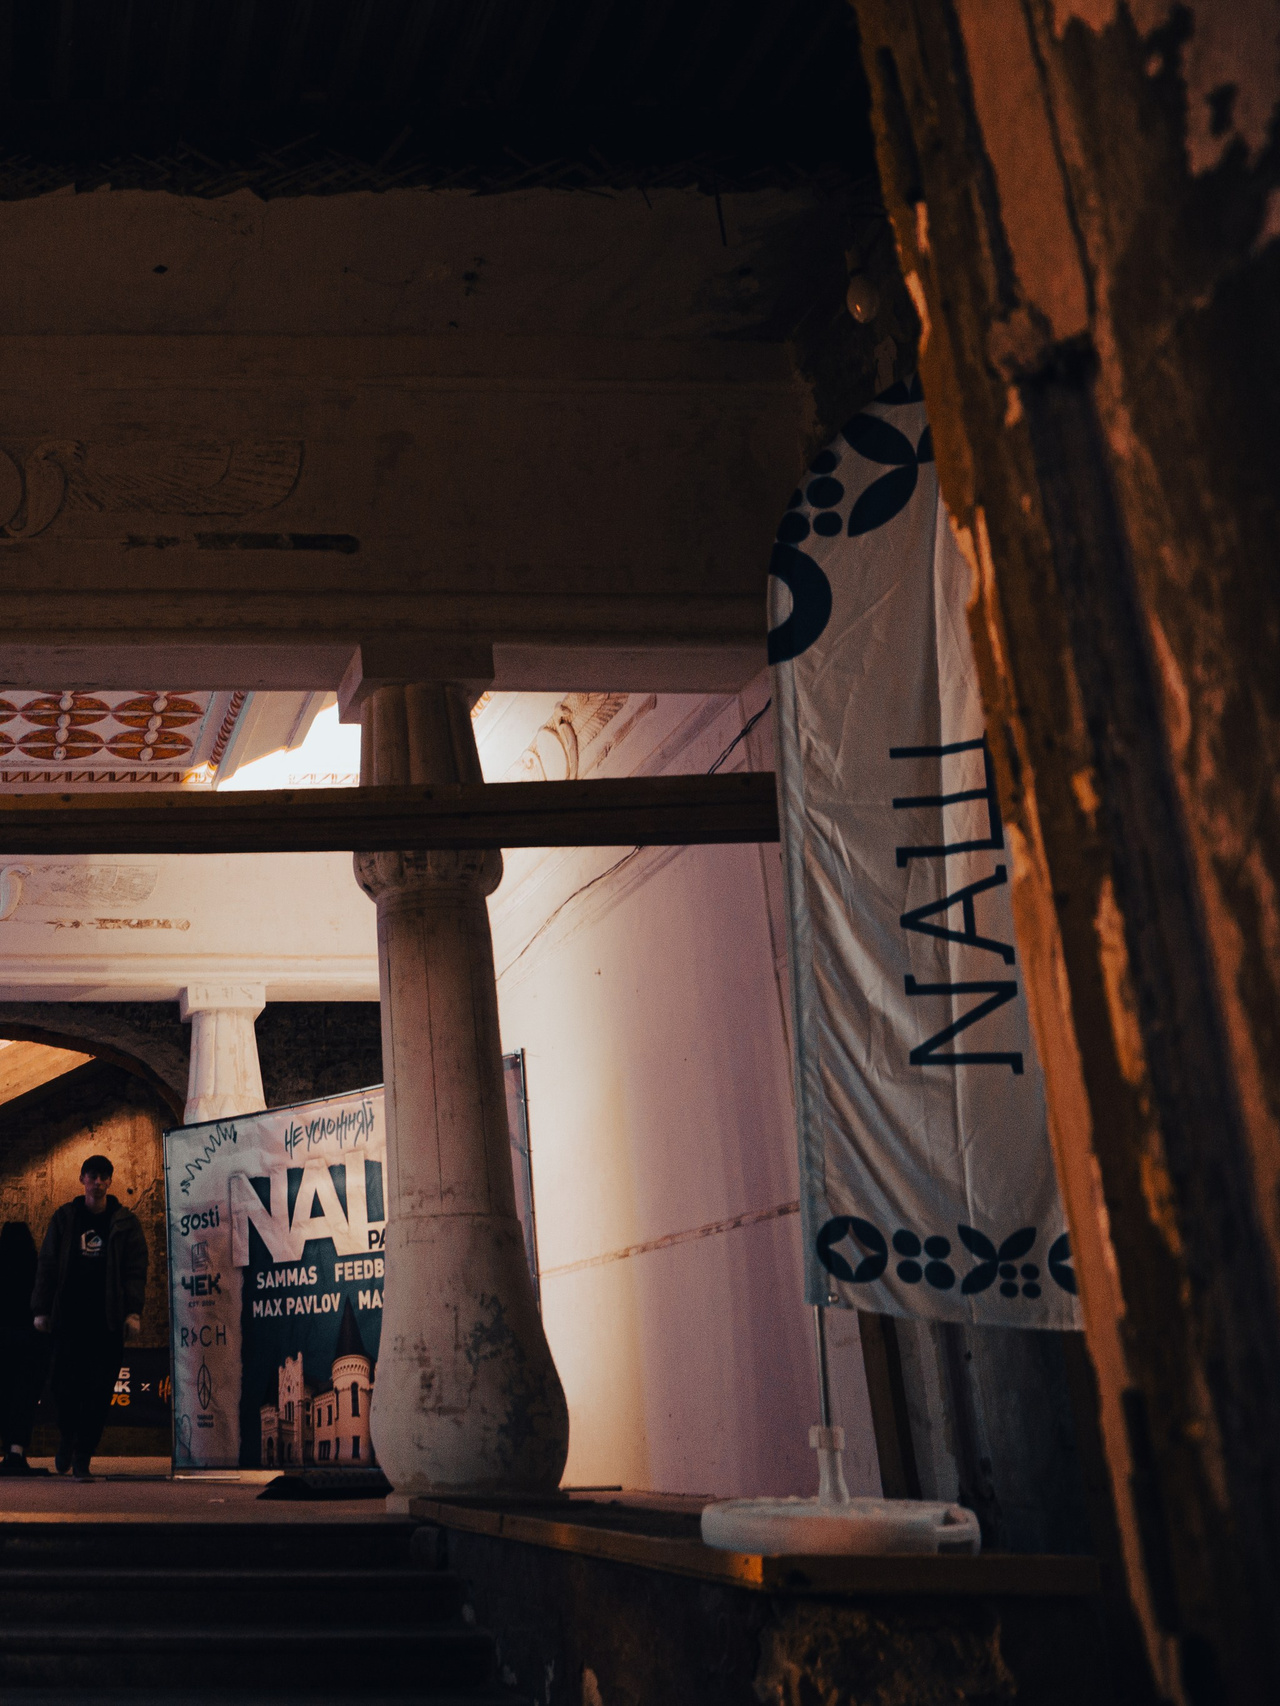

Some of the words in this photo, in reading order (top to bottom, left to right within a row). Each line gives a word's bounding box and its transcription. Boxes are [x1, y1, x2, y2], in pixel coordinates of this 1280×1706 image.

[180, 1205, 220, 1237] gosti
[181, 1272, 222, 1297] ЧЕК
[256, 1265, 318, 1290] SAMMAS
[252, 1298, 283, 1319] MAX
[286, 1292, 341, 1317] PAVLOV
[358, 1289, 385, 1311] MA
